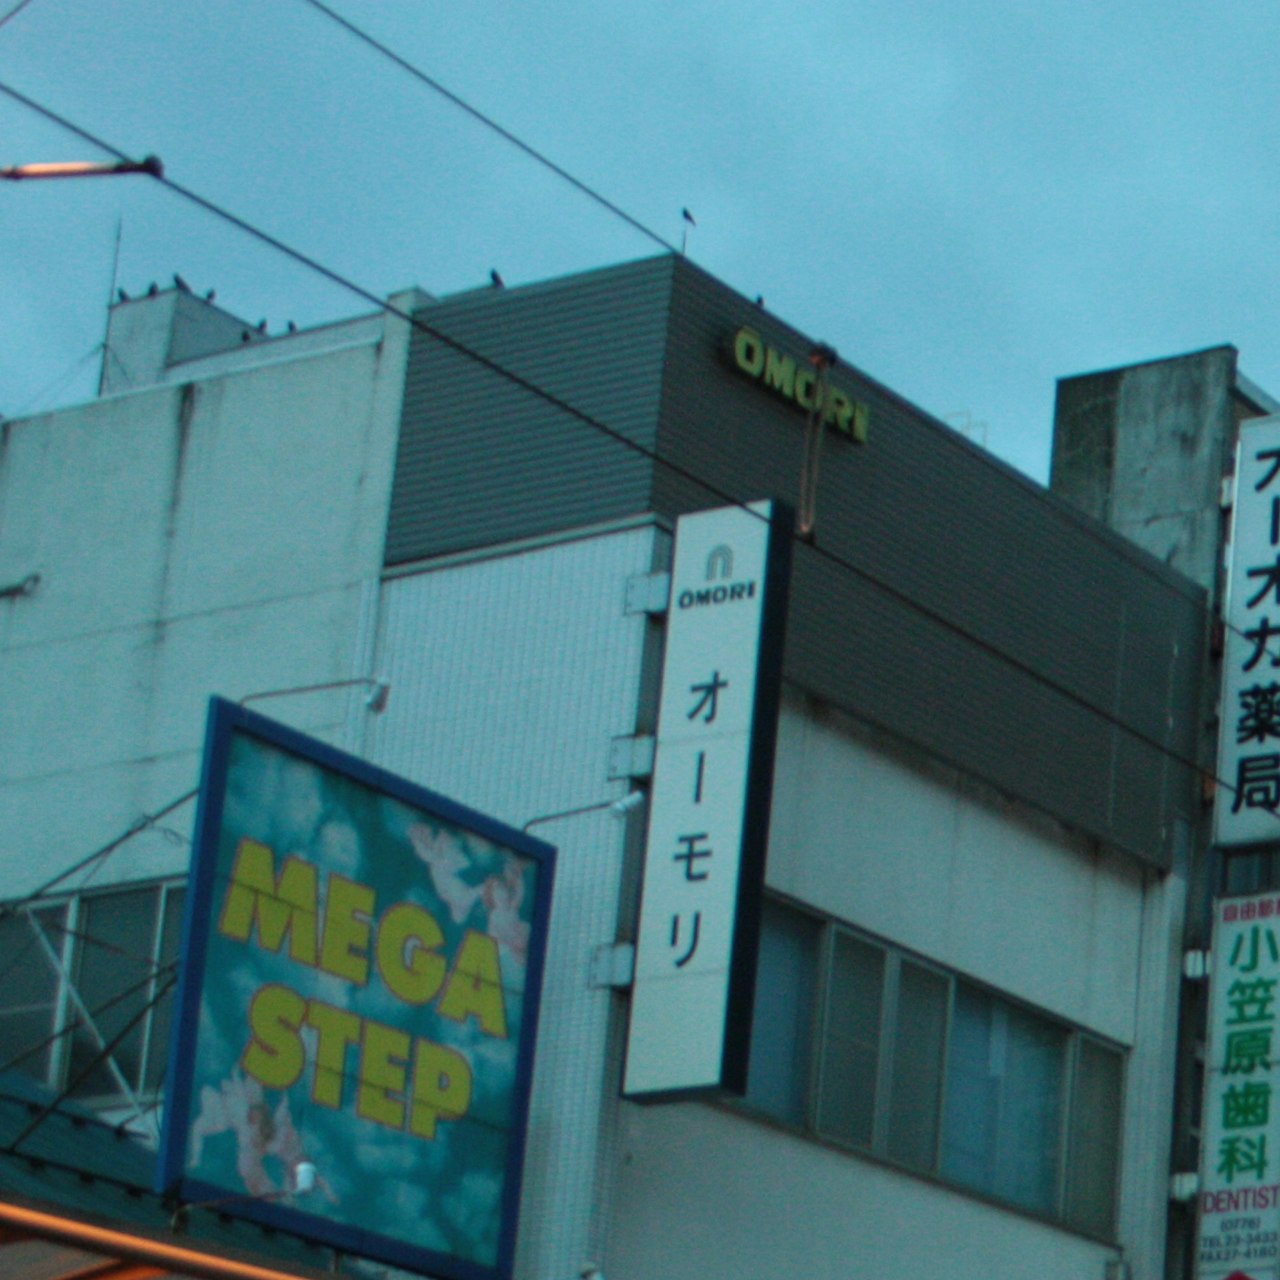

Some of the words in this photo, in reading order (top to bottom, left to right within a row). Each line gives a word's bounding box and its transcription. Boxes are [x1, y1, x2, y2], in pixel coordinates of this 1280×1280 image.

[734, 325, 871, 443] OMORI
[679, 580, 755, 609] OMORI
[669, 670, 728, 968] オーモリ
[217, 836, 510, 1038] MEGA
[241, 983, 474, 1140] STEP
[1217, 925, 1280, 1183] 小笠原歯科
[1201, 1184, 1280, 1214] DENTIST
